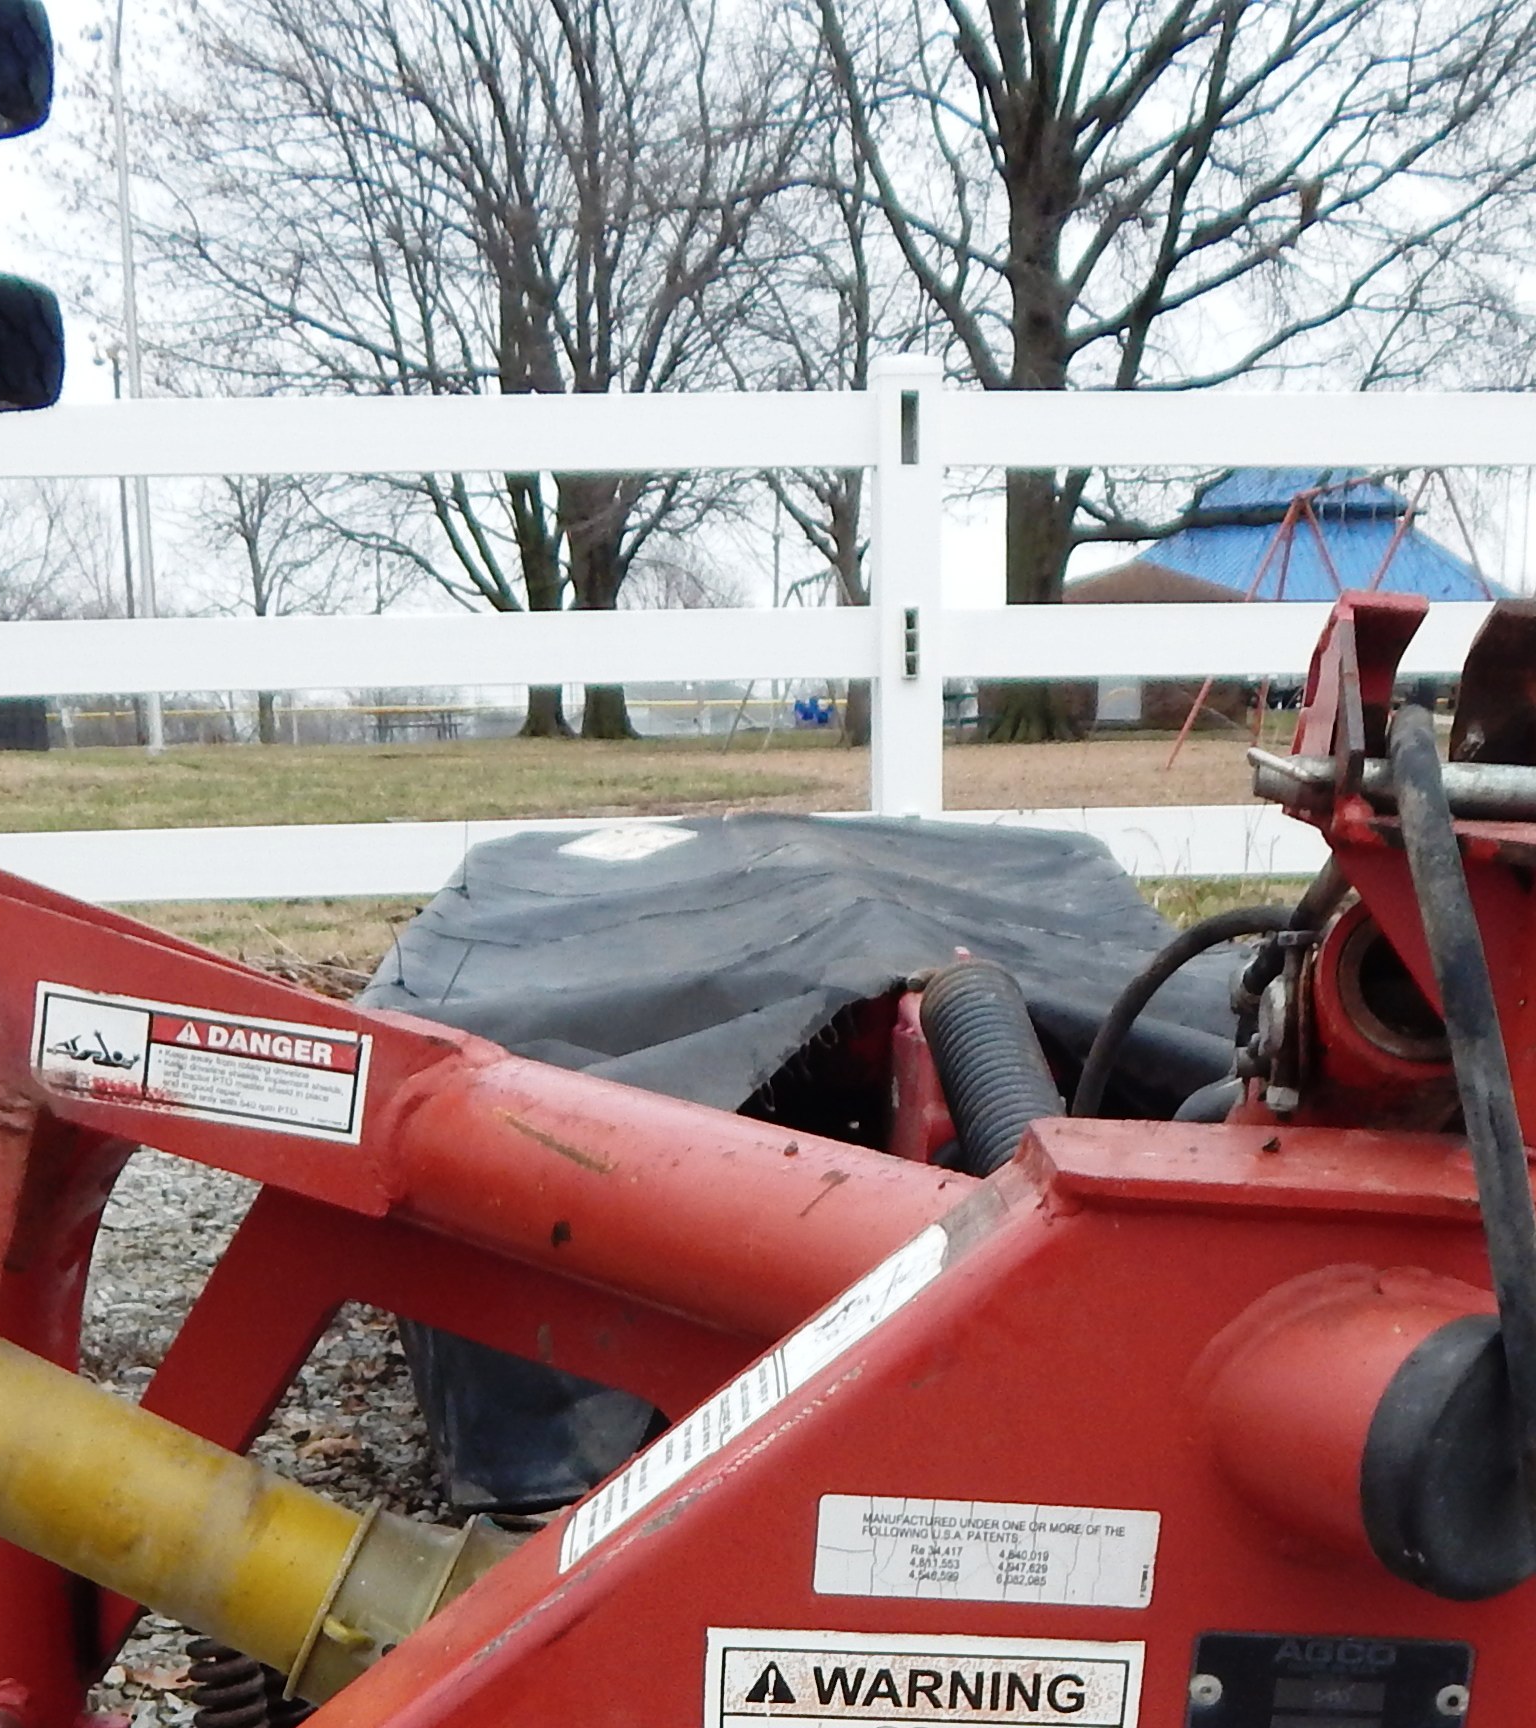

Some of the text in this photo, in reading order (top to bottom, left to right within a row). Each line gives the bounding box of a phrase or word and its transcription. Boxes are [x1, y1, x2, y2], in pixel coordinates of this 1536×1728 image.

[207, 1025, 333, 1065] DANGER
[861, 1524, 929, 1539] FOLLOWING
[862, 1512, 1126, 1536] MANUFACTURED UNDER ONE OR MORE OF THE
[1274, 1639, 1397, 1666] AGCO
[813, 1665, 1086, 1714] WARNING
